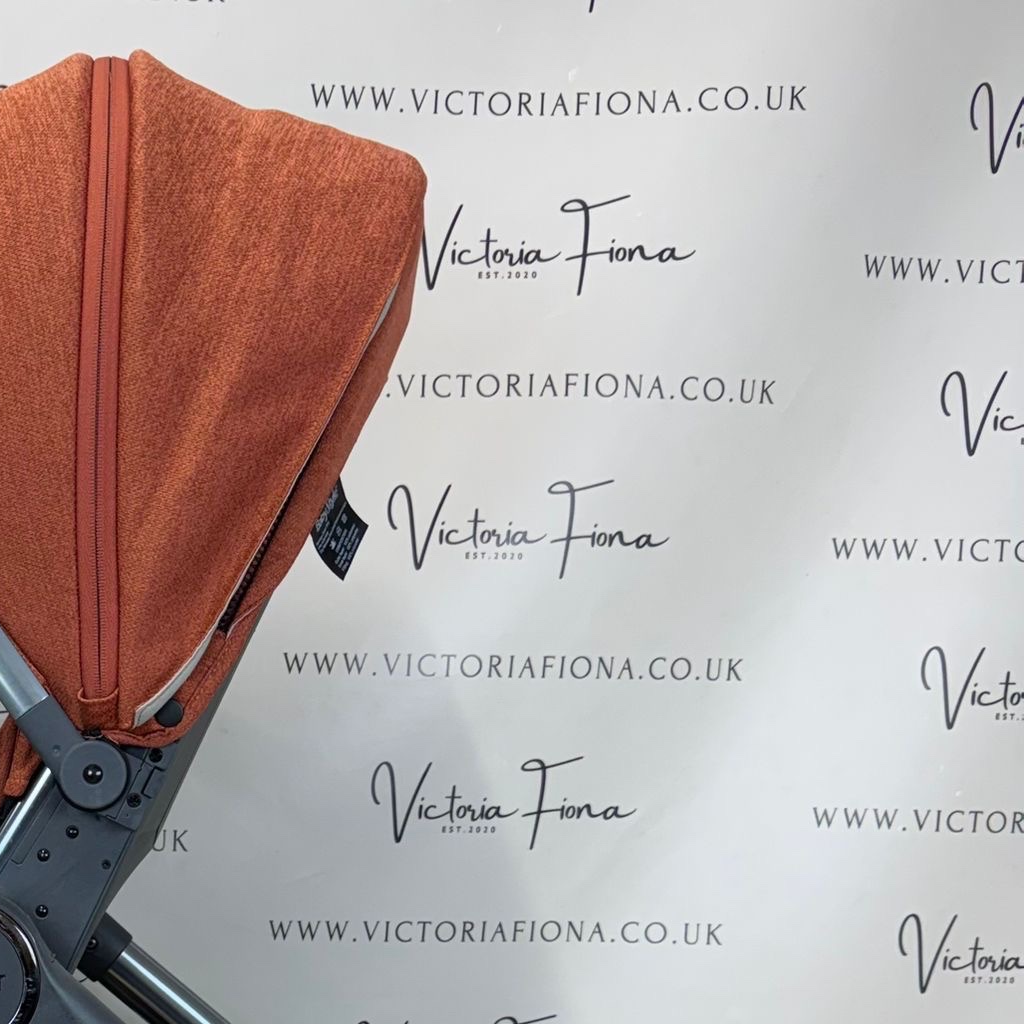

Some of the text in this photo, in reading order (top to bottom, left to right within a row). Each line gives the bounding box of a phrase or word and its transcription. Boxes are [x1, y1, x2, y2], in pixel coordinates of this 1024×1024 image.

[311, 83, 807, 116] WWW.VICTORIAFIONA.CO.UK
[422, 195, 696, 296] Victoria Fiona
[477, 270, 538, 280] EST.2020
[386, 373, 775, 404] .VICTORIAFIONA.CO.UK
[387, 484, 547, 571] Victoria
[548, 479, 670, 579] Fiona
[464, 551, 523, 561] EST.2020
[283, 652, 743, 681] WWW.VICTORIAFIONA.CO.UK
[921, 646, 1024, 730] Victo
[371, 756, 637, 850] Victoria Fiona
[441, 825, 496, 834] EST.2020
[269, 920, 722, 945] WWW.VICTORIAFIONA.CO.UK
[963, 976, 1015, 985] EST.2020
